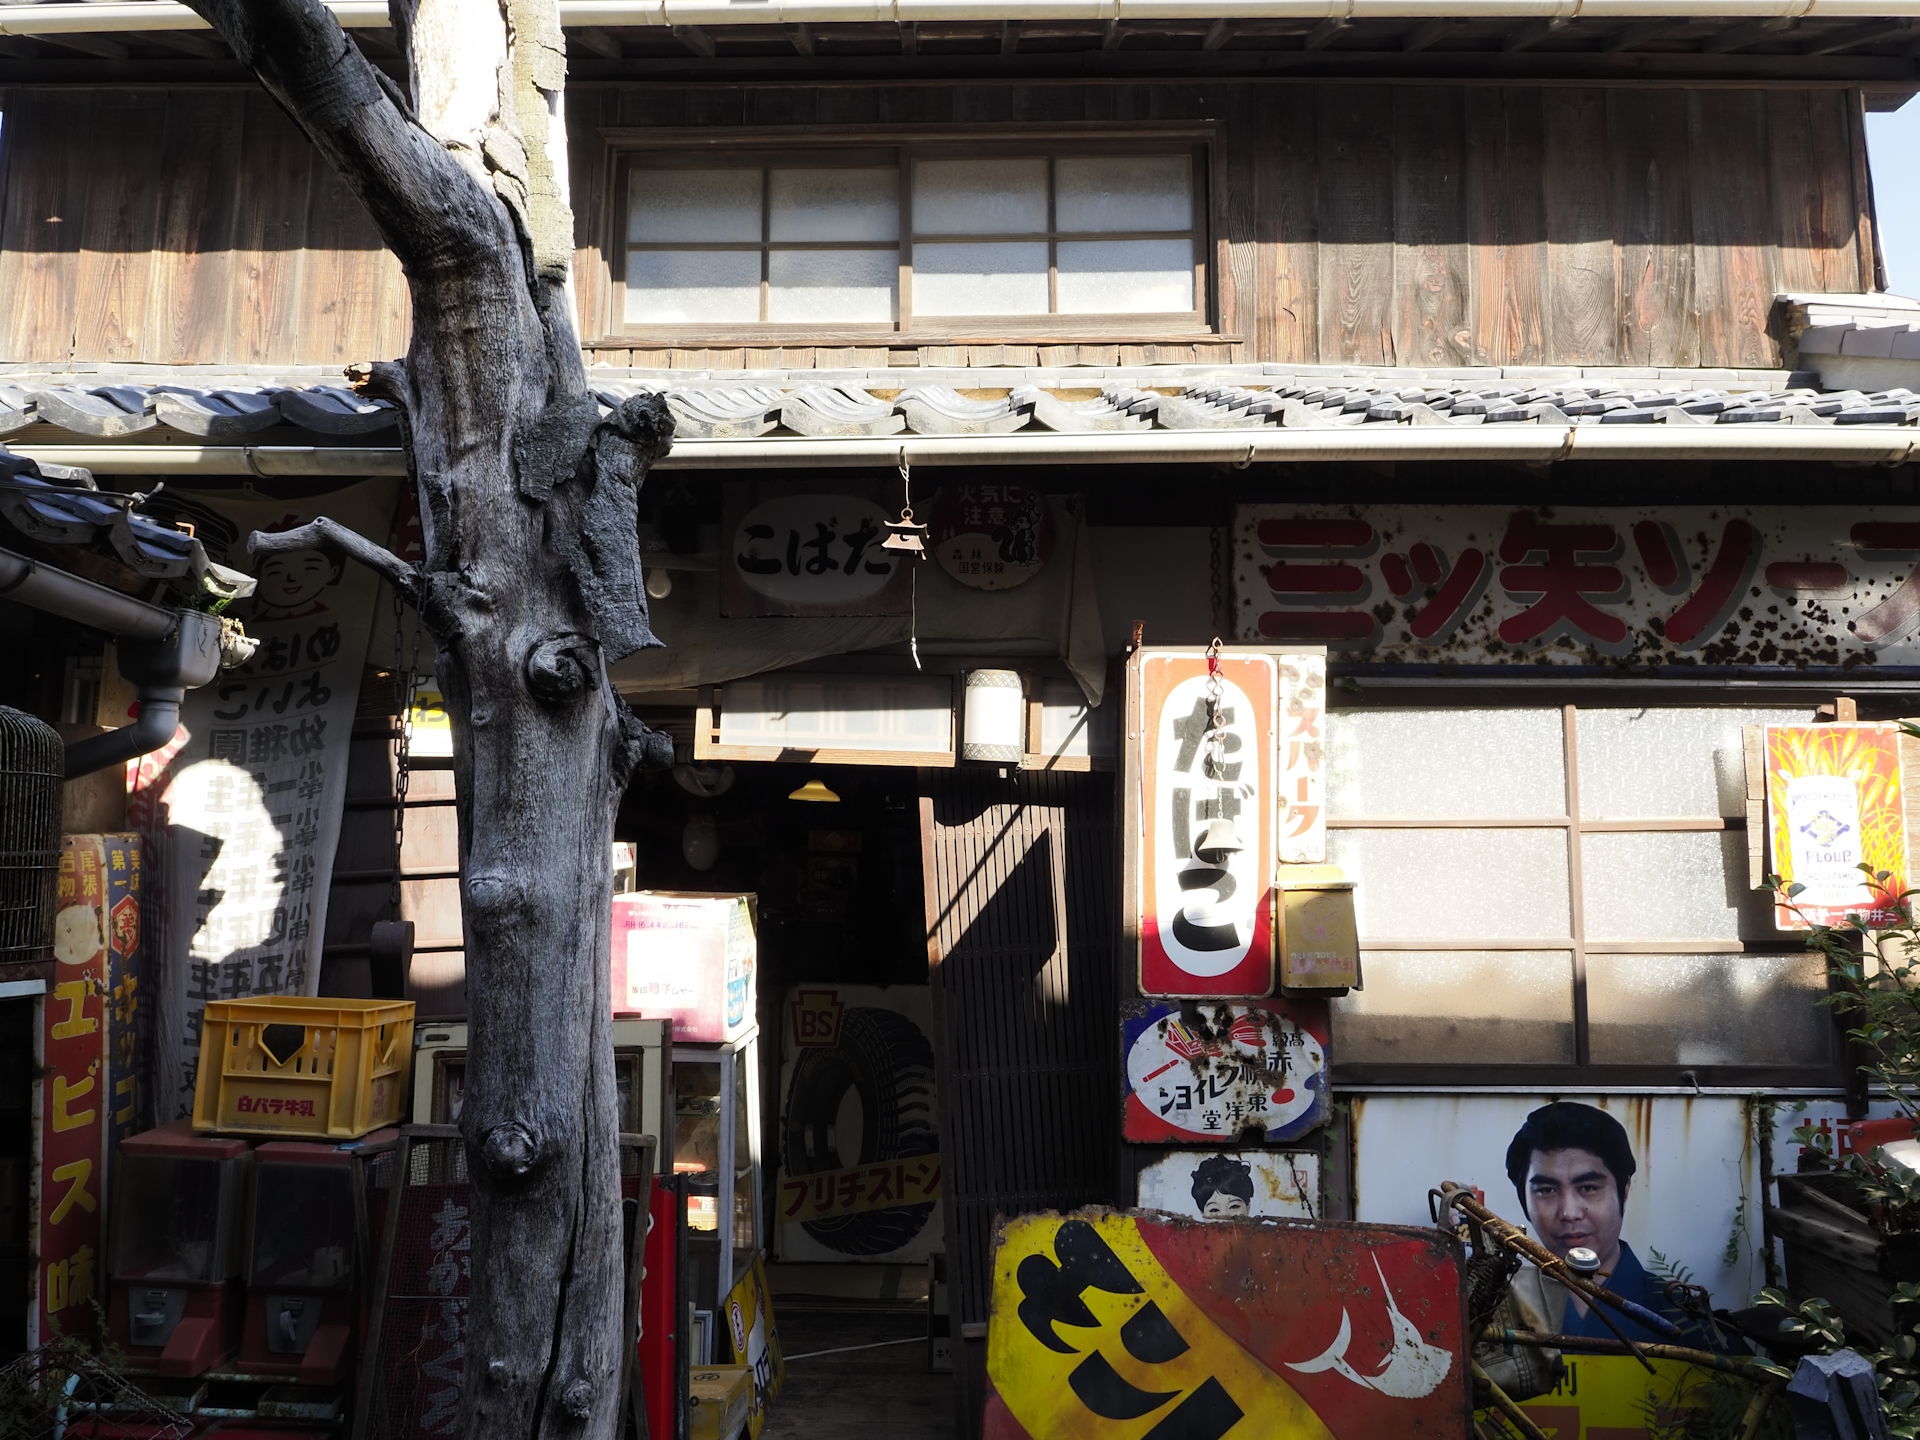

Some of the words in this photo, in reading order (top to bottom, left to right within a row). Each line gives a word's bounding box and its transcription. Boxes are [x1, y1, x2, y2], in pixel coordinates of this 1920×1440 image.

[957, 483, 1022, 504] 火気に
[963, 505, 1007, 525] 注意
[951, 548, 983, 560] 森林
[959, 561, 1005, 575] 国営保険
[1172, 695, 1256, 952] たばこ
[111, 849, 127, 887] 第一
[616, 846, 635, 864] KIRIN
[80, 850, 99, 897] 尾張
[800, 1009, 833, 1038] BS
[1272, 1032, 1305, 1048] 高級
[113, 973, 139, 1138] キッコ
[237, 1094, 316, 1117] 白バラ牛乳
[1202, 1092, 1268, 1130] 東洋堂
[46, 979, 101, 1380] エビス味
[782, 1161, 942, 1218] ブリヂストン
